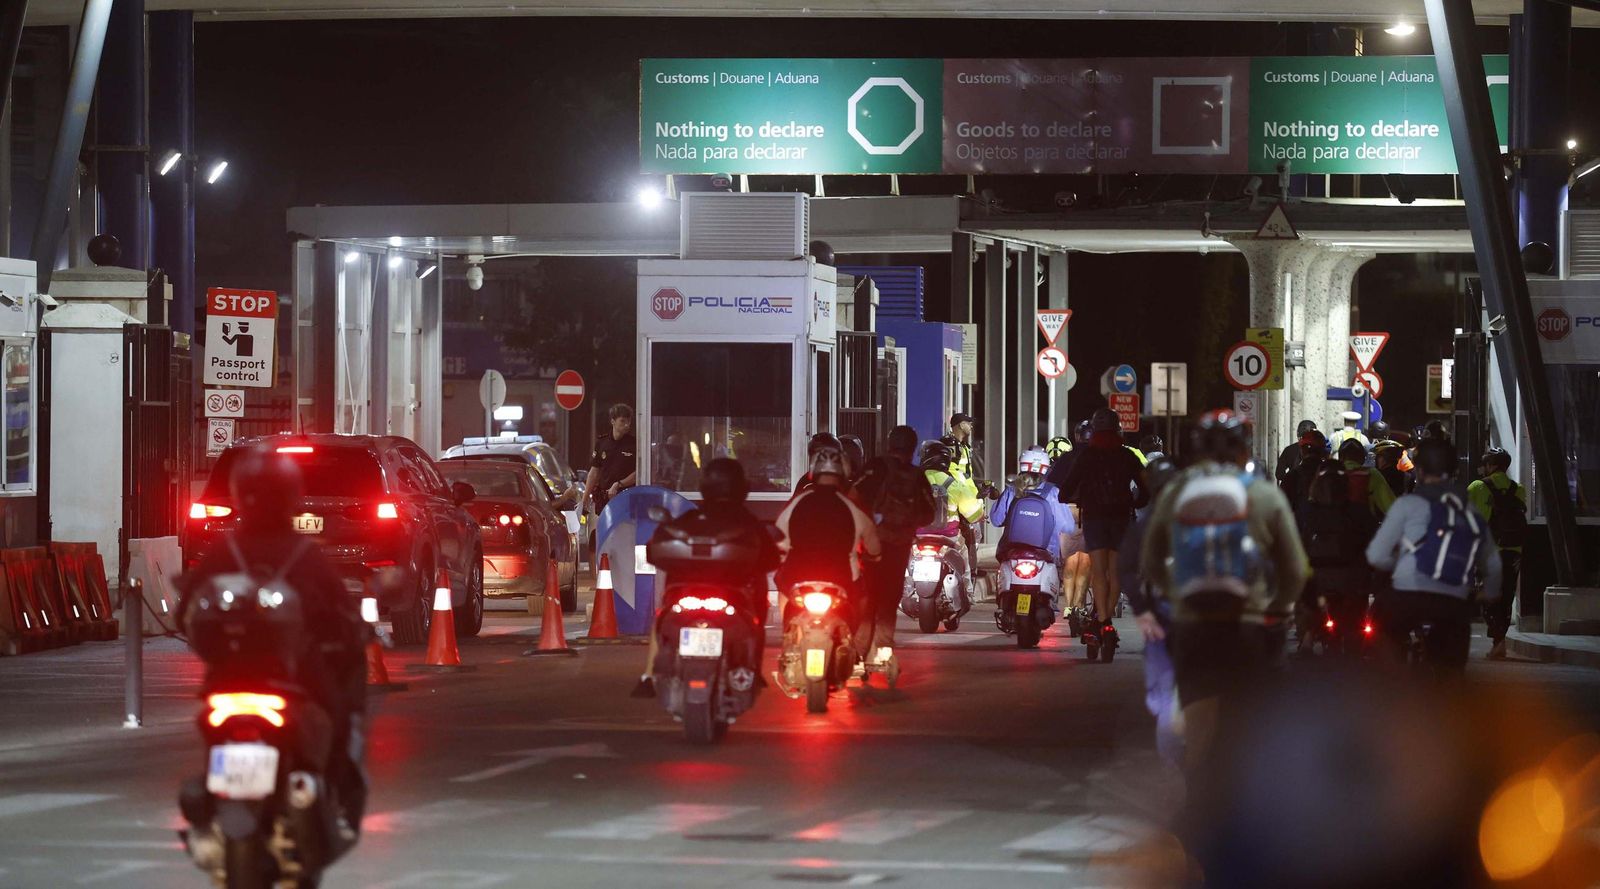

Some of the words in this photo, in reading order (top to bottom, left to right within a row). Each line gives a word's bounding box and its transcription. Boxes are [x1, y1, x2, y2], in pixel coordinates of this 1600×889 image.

[655, 72, 710, 84] Customs
[720, 72, 764, 84] Douane
[774, 72, 819, 84] Aduana
[957, 72, 1011, 84] Customs
[1264, 71, 1320, 83] Customs
[1331, 71, 1377, 83] Douane
[1387, 71, 1434, 83] Aduana
[655, 121, 728, 142] Nothing
[734, 123, 754, 138] to
[758, 121, 824, 138] declare
[956, 121, 1015, 138] Goods
[1021, 123, 1040, 138] to
[1046, 121, 1112, 138] declare
[1263, 121, 1339, 141] Nothing
[1345, 122, 1365, 137] to
[1370, 120, 1439, 137] declare
[655, 143, 697, 160] Nada
[703, 147, 738, 163] para
[743, 143, 808, 160] declarar
[956, 143, 1018, 164] Objetos
[1024, 147, 1059, 163] para
[1065, 143, 1129, 160] declarar
[1263, 143, 1306, 160] Nada
[1313, 146, 1349, 163] para
[1355, 142, 1422, 160] declarar
[213, 294, 271, 313] STOP
[655, 297, 682, 311] STOP
[688, 296, 771, 308] POLICIA
[1041, 314, 1064, 322] GIVE
[1538, 317, 1568, 331] STOP
[1353, 337, 1378, 346] GIVE
[211, 356, 266, 370] Passport
[1233, 354, 1262, 377] 10
[216, 370, 260, 382] control
[1116, 395, 1132, 403] NEW
[1120, 412, 1137, 421] YOUT
[298, 518, 321, 530] LFV
